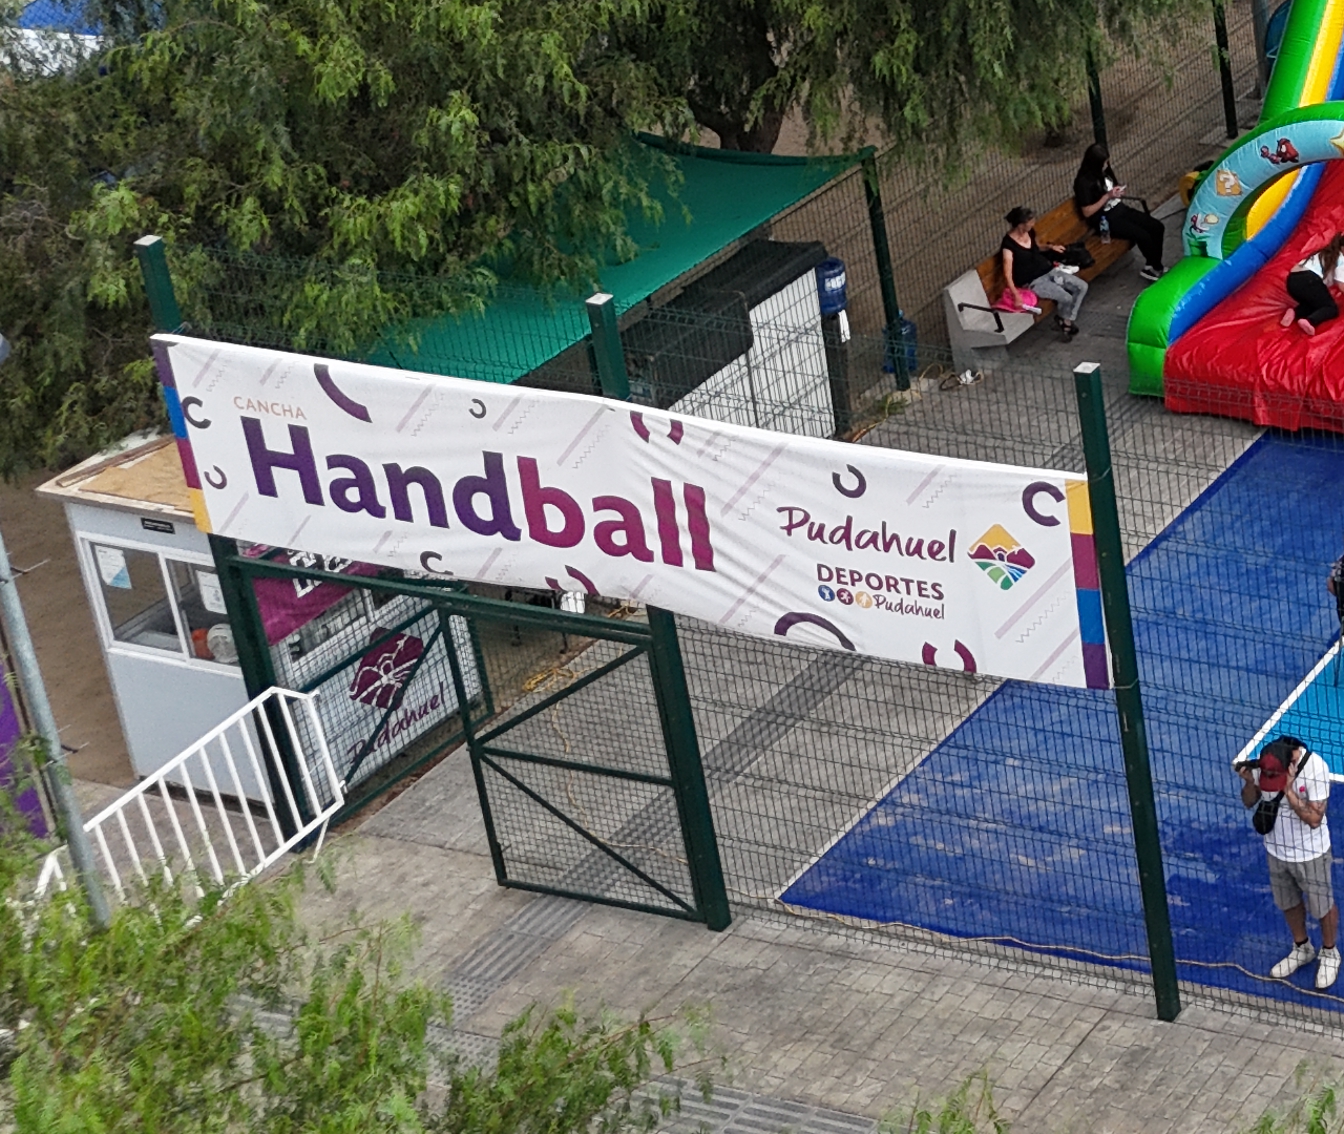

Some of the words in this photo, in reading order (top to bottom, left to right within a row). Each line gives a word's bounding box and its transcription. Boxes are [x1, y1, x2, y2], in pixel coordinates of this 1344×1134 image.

[233, 396, 307, 420] CANCHA
[240, 415, 716, 572] Handball
[776, 506, 957, 563] Pudahuel
[816, 563, 945, 601] DEPORTES
[872, 593, 945, 620] Pudahuel
